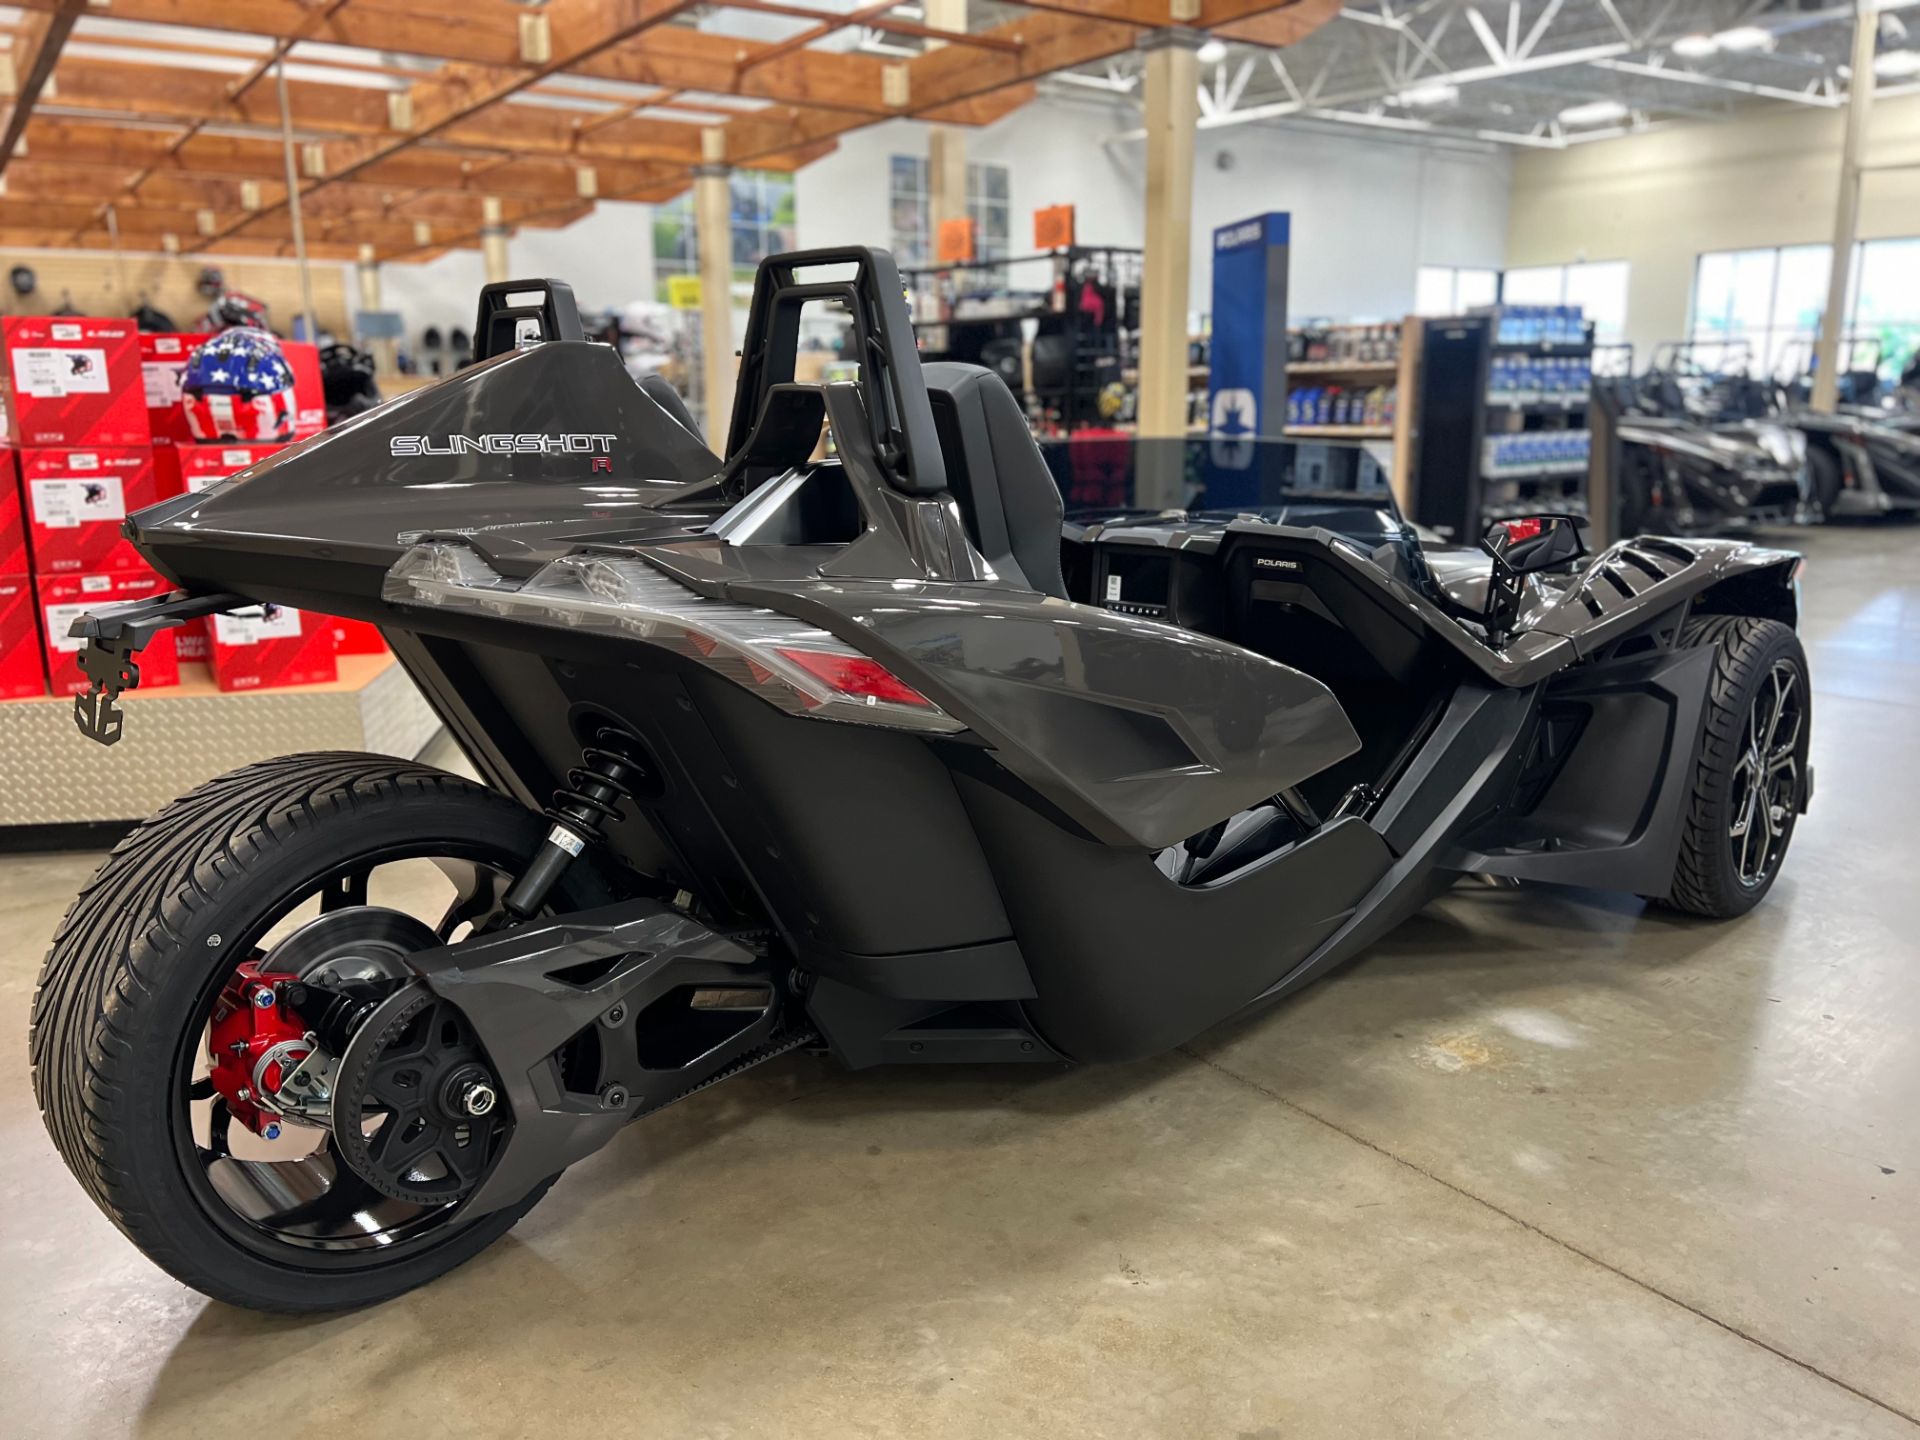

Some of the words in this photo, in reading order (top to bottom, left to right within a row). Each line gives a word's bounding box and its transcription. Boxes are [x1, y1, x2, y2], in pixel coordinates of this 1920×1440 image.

[390, 434, 617, 456] SLINGSHOT
[591, 456, 613, 473] R
[1257, 558, 1297, 569] POLARIS
